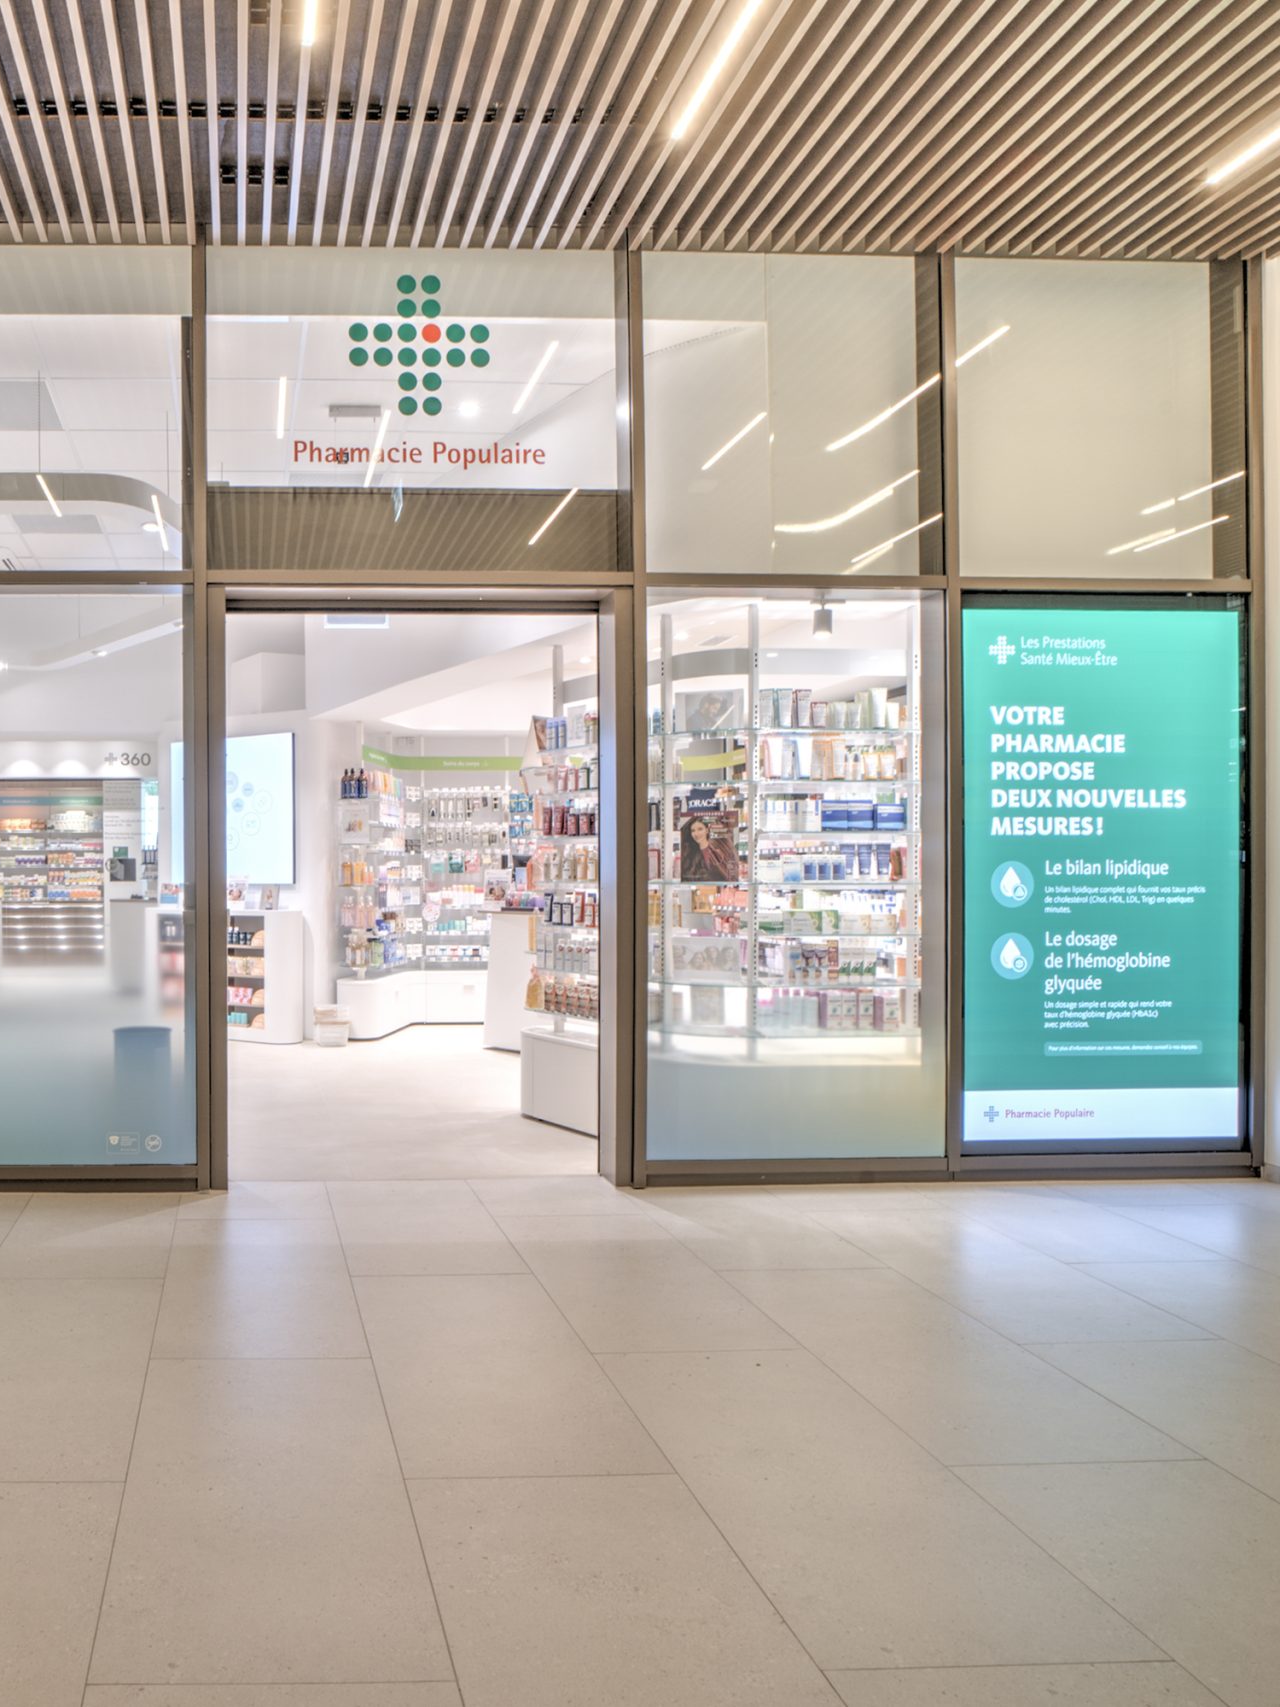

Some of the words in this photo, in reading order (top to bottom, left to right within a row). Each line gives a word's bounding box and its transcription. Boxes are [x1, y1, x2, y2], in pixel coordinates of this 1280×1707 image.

[293, 440, 423, 464] Pharmacie
[432, 441, 546, 470] Populaire
[1020, 636, 1041, 649] Les
[1042, 635, 1107, 650] Prestations
[1020, 651, 1054, 666] Santé
[1055, 650, 1119, 667] Mieux-Être
[989, 705, 1065, 726] VOTRE
[990, 734, 1126, 754] PHARMACIE
[121, 752, 152, 767] 360
[990, 761, 1095, 781] PROPOSE
[991, 788, 1053, 808] DEUX
[1056, 789, 1188, 809] NOUVELLES
[1045, 860, 1062, 876] Le
[1065, 859, 1102, 876] bilan
[1105, 859, 1170, 880] lipidique
[1044, 886, 1054, 894] Un
[1099, 885, 1125, 895] complet
[1044, 895, 1053, 904] de
[1045, 931, 1062, 947] Le
[1065, 930, 1118, 951] dosage
[1044, 952, 1064, 969] de
[1044, 974, 1103, 996] glyquée
[1044, 1001, 1054, 1009] Un
[1005, 1108, 1051, 1119] Pharmacie
[1053, 1108, 1095, 1120] Populaire
